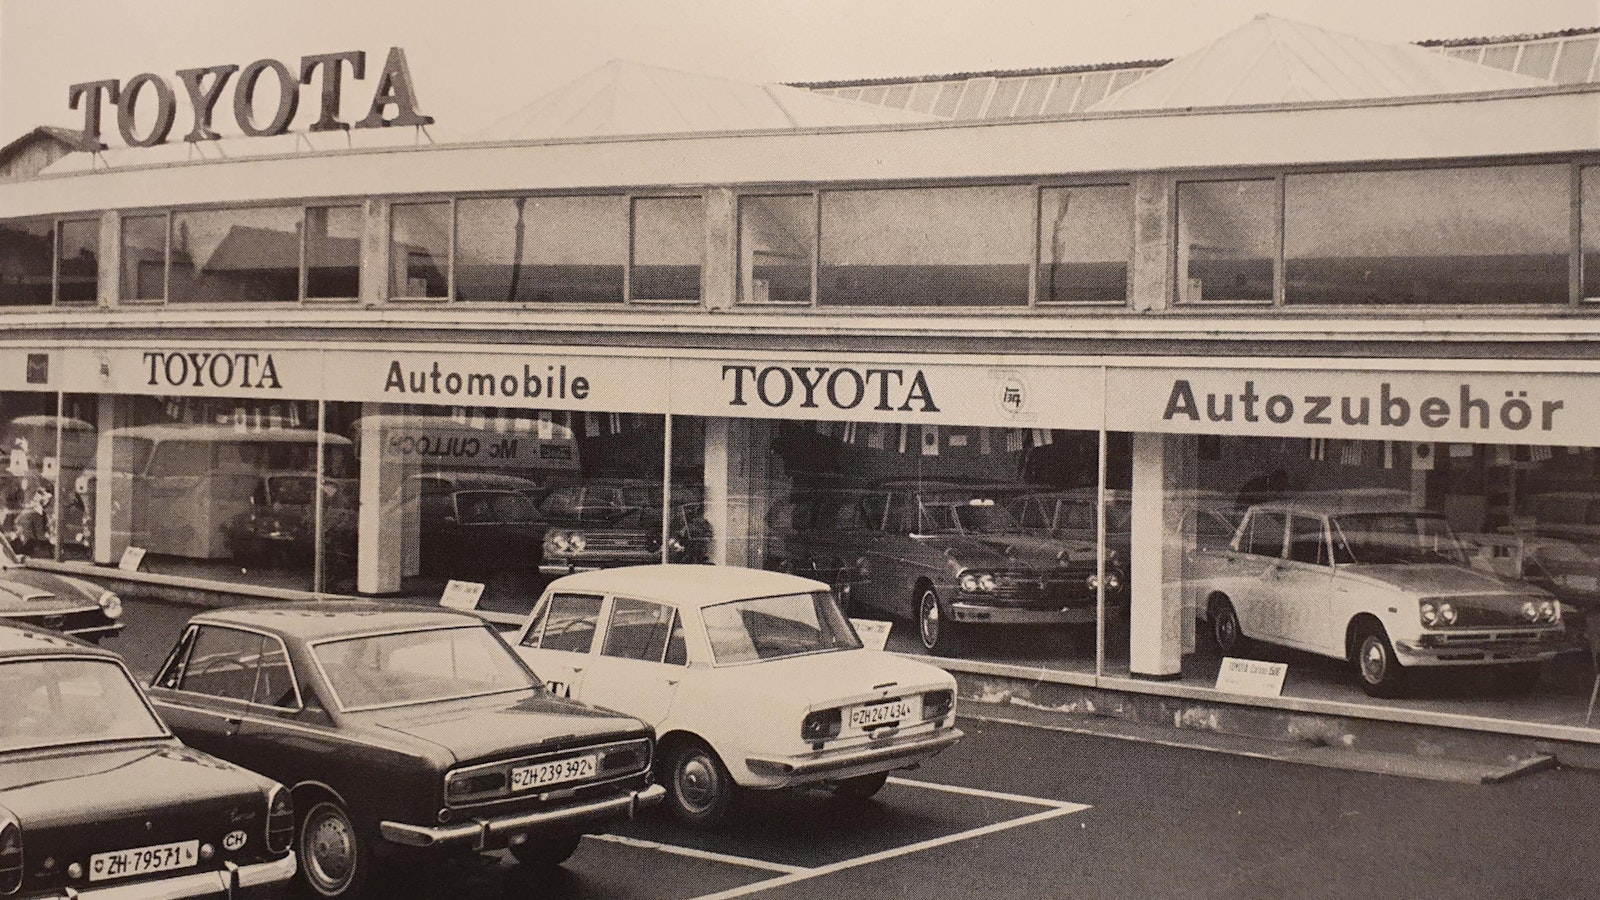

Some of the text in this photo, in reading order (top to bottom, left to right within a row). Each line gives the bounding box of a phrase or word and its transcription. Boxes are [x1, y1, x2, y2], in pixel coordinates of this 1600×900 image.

[69, 46, 435, 151] TOYOTA
[143, 351, 283, 389] TOYOTA
[384, 360, 591, 399] Automobile
[722, 364, 941, 413] TOYOTA
[1162, 379, 1565, 432] Autozubehör
[522, 769, 538, 786] ZH
[225, 834, 244, 847] CH
